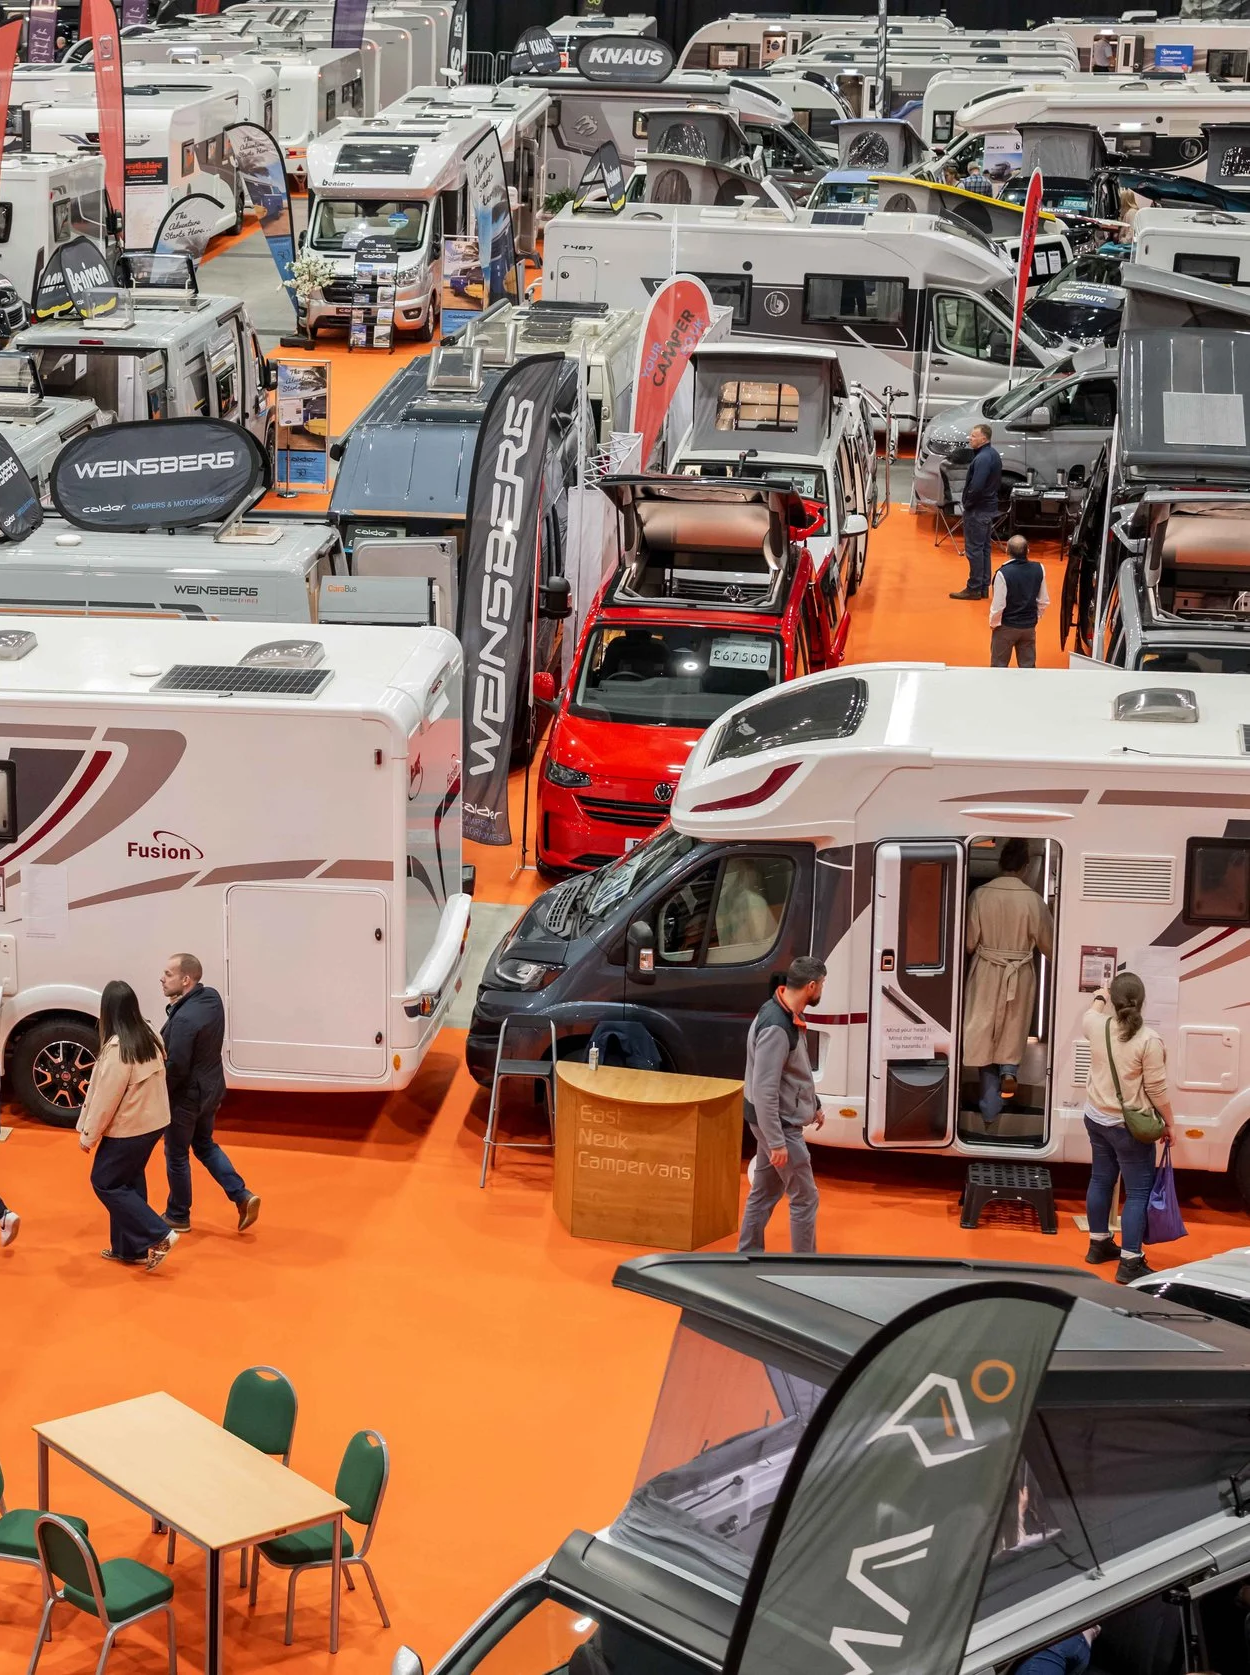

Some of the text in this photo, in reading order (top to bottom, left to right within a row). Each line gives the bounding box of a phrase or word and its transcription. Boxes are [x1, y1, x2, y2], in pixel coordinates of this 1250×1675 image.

[529, 37, 554, 57] KNAUS
[587, 47, 664, 66] KNAUS
[1062, 292, 1107, 304] AUTOMATIC
[652, 308, 696, 387] CAMPER
[641, 342, 663, 379] YOUR
[74, 451, 235, 480] WEINSBERG
[82, 504, 127, 514] calder
[131, 502, 166, 511] CAMPERS
[166, 501, 172, 509] &
[354, 528, 390, 537] calder
[173, 584, 259, 597] WEINSBERG
[327, 584, 358, 593] CaraBus
[469, 396, 535, 776] WEINSBERG
[713, 649, 767, 664] £67500
[127, 842, 190, 860] Fusion
[901, 1028, 912, 1036] your
[580, 1104, 623, 1125] East
[578, 1127, 628, 1150] Neuk
[577, 1151, 691, 1180] Campervans
